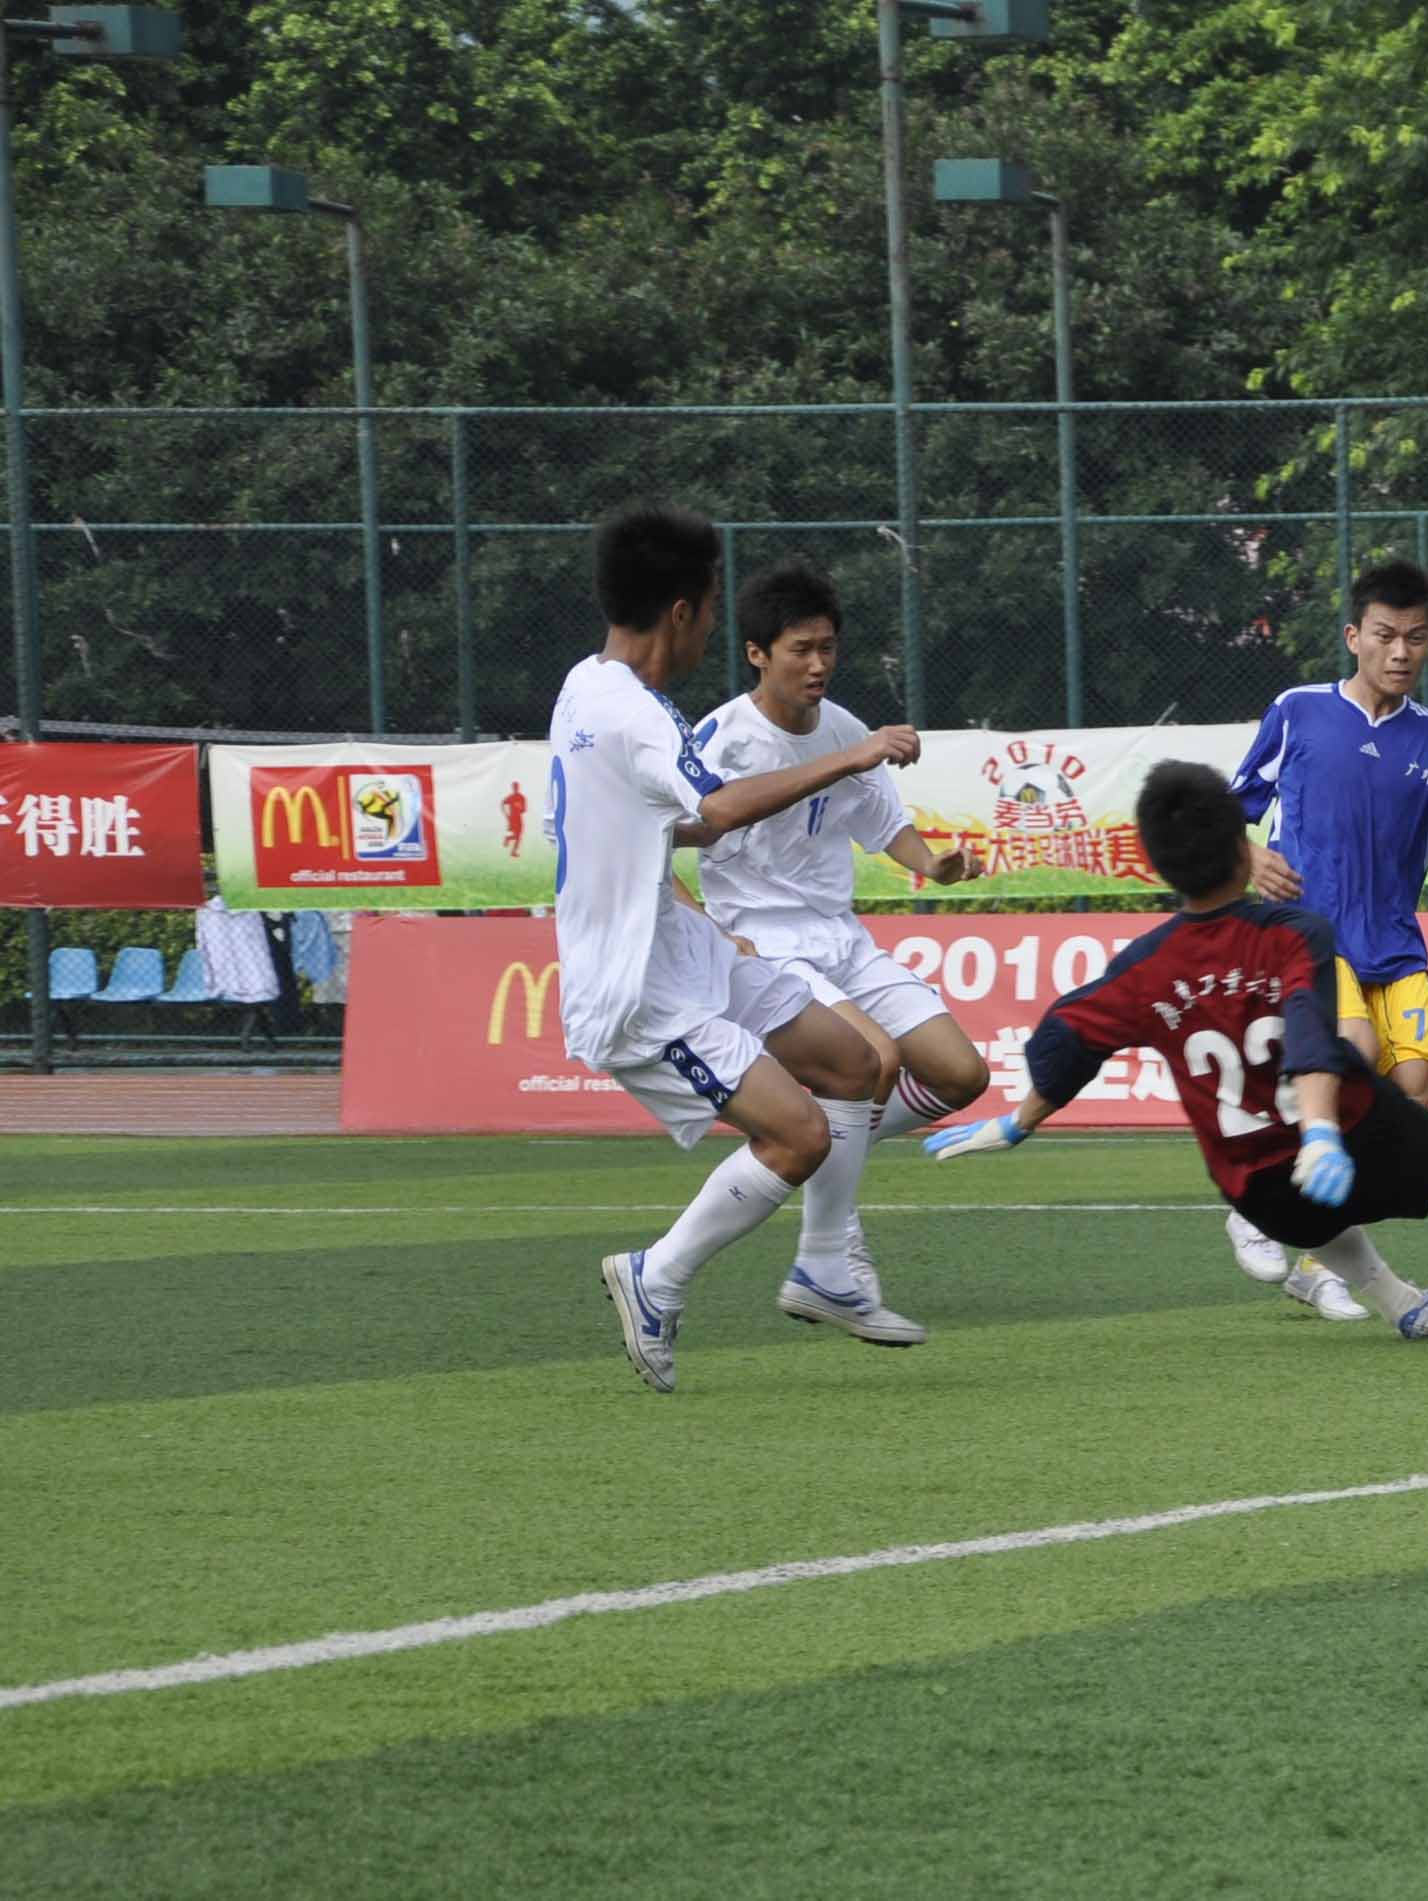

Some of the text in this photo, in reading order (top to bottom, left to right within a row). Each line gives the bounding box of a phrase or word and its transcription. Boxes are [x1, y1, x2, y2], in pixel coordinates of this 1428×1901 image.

[982, 740, 1086, 786] 2010
[0, 793, 145, 857] 得胜
[992, 798, 1088, 829] 麦当劳
[290, 869, 406, 882] official restaurant
[892, 936, 1136, 1000] 2010
[1402, 1008, 1426, 1041] 7
[518, 1074, 580, 1092] official
